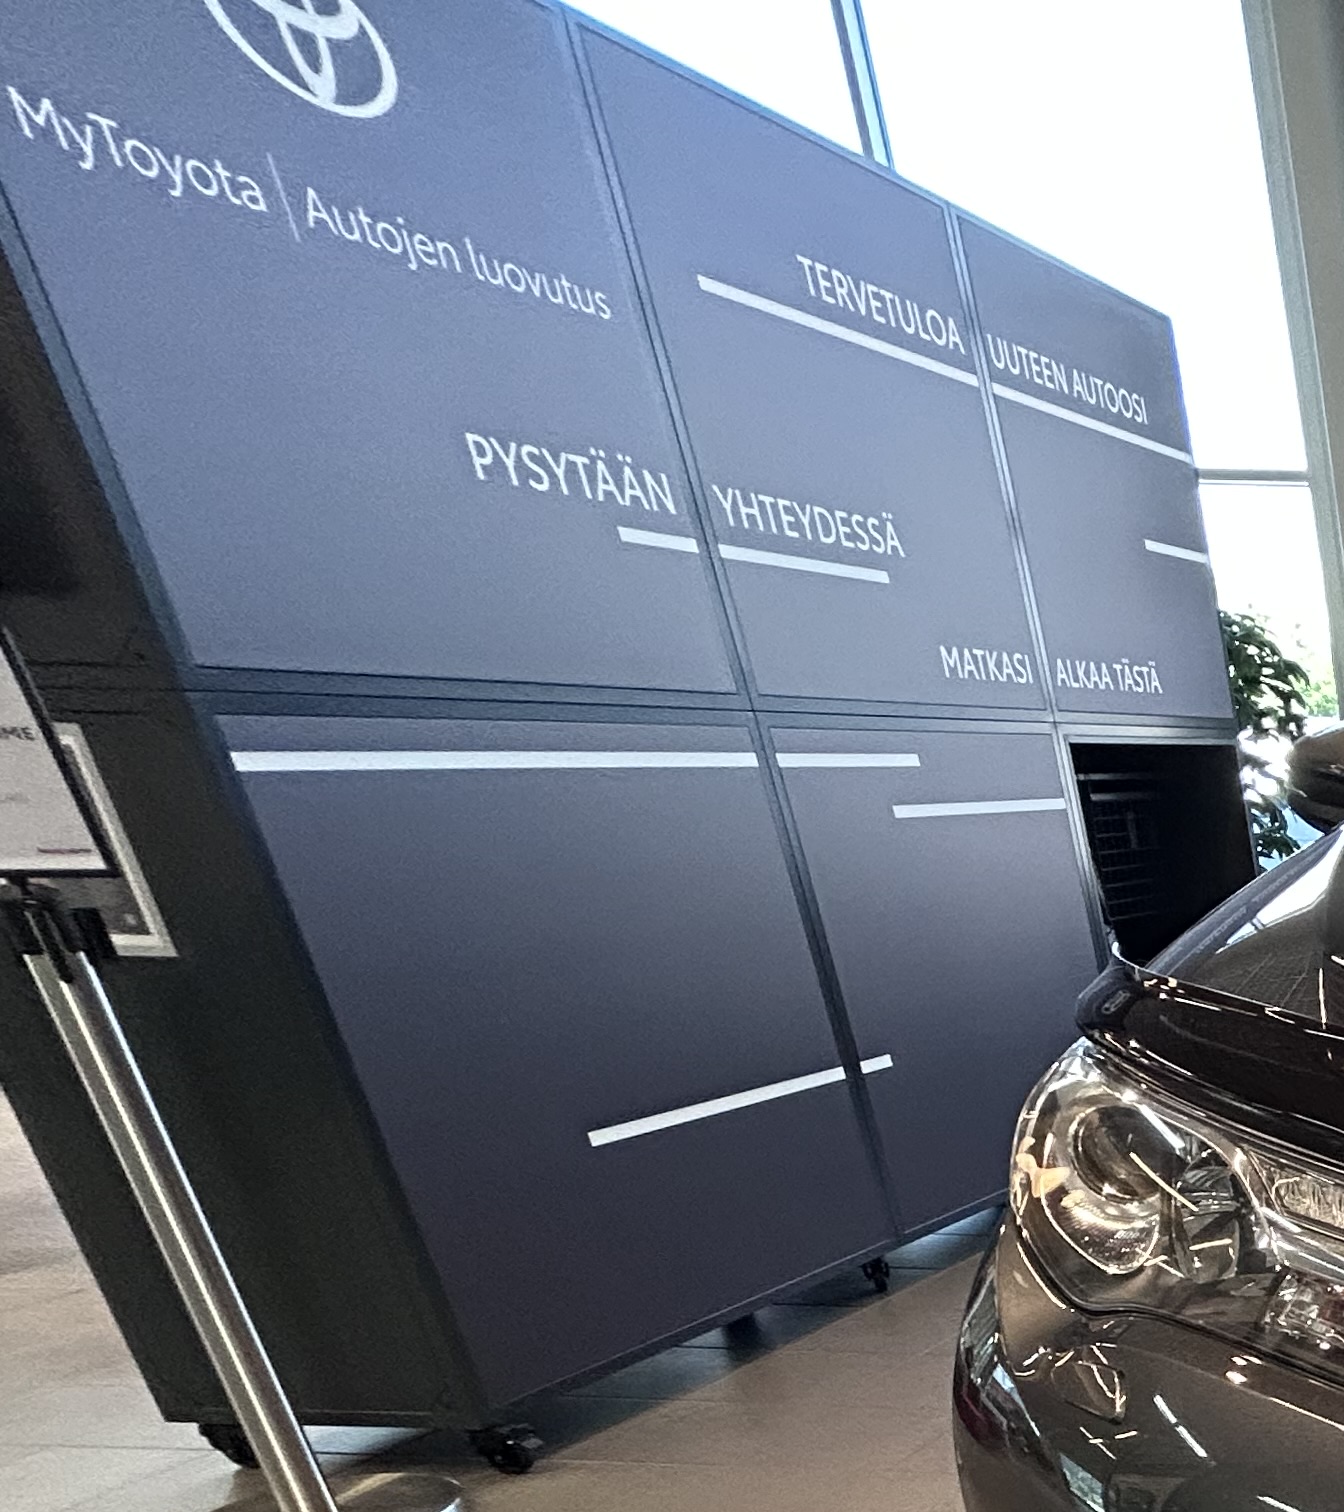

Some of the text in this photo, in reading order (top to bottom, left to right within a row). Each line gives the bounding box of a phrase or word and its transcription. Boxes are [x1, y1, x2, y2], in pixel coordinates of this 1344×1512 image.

[7, 85, 611, 319] MyToyota Autojen luovutus
[796, 254, 1149, 425] TERVETULOA UUTEEN AUTOOSI
[465, 432, 905, 557] PYSYTÄÄN YHTEYDESSÄ
[939, 645, 1163, 694] MATKASI ALKAA TÄSTÄ
